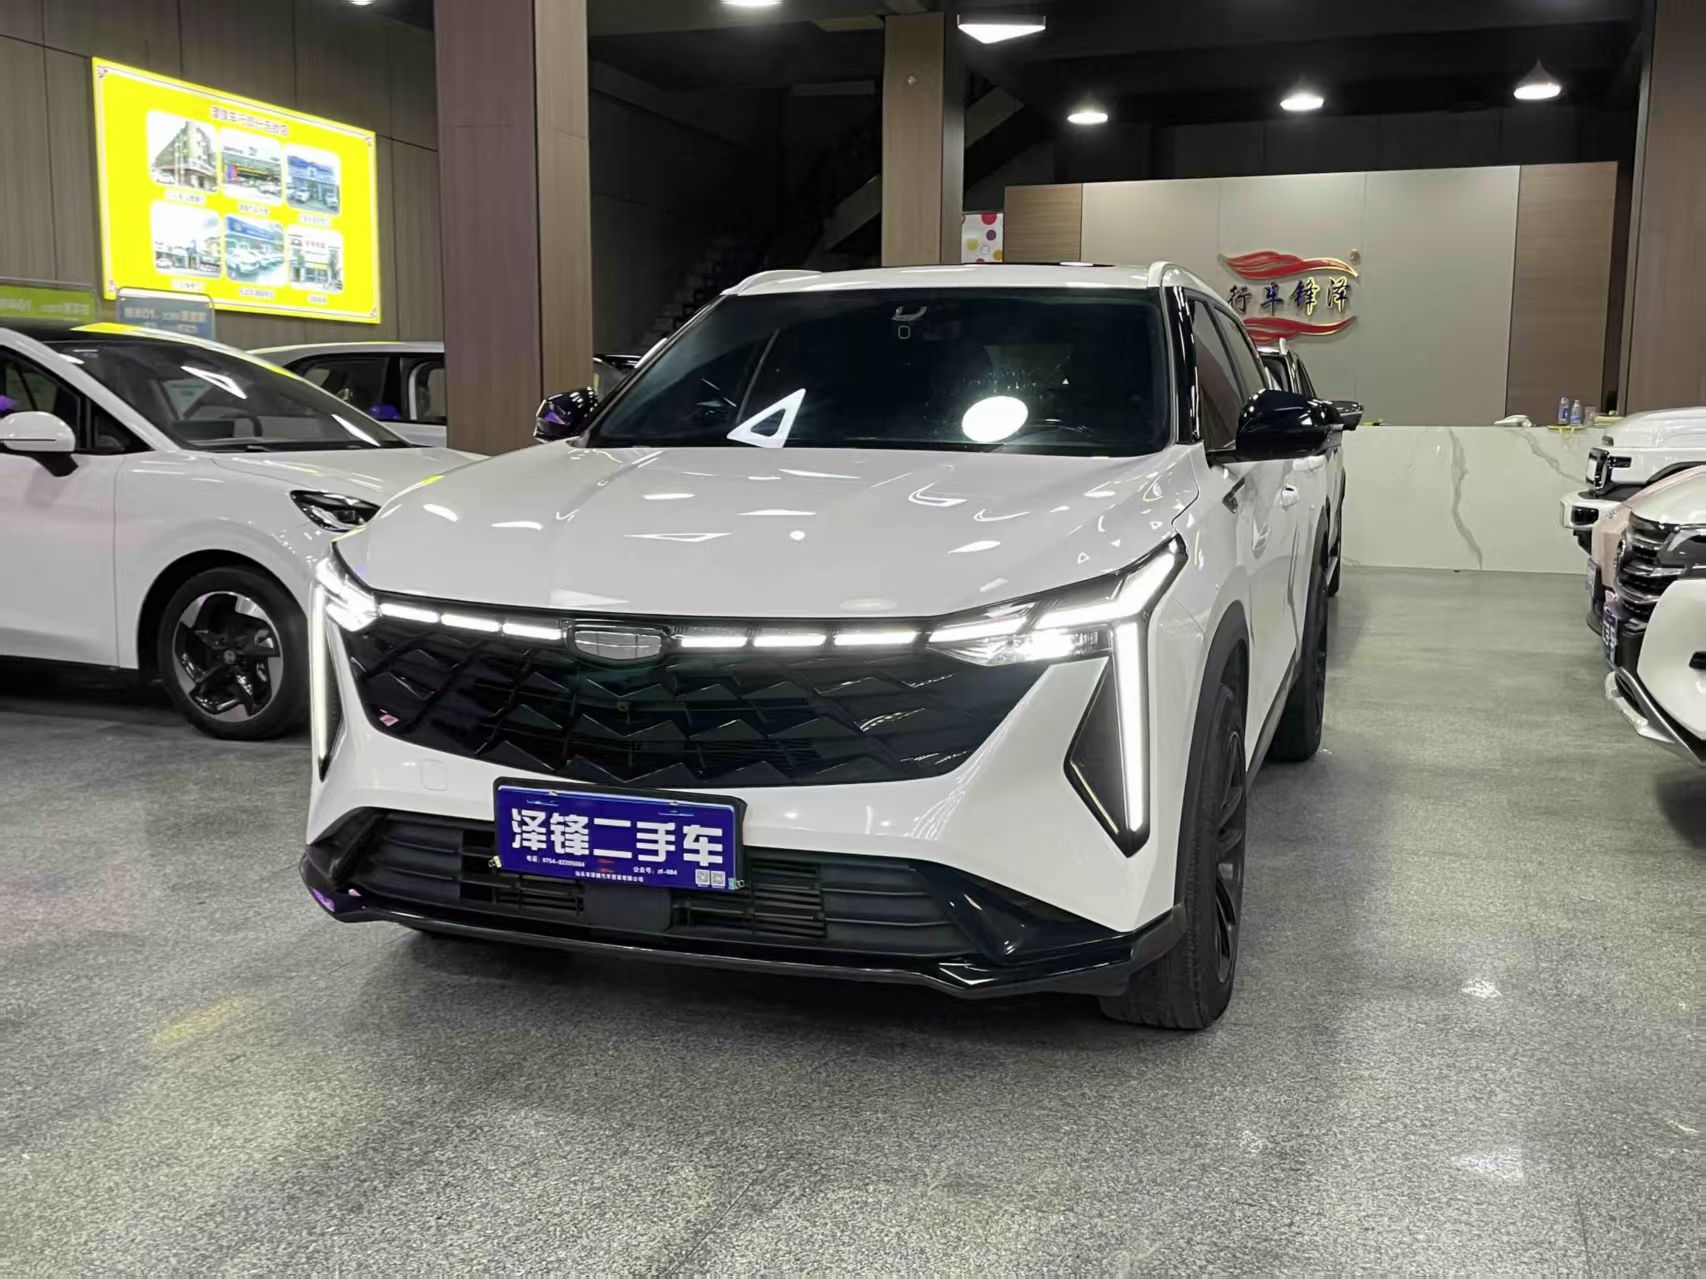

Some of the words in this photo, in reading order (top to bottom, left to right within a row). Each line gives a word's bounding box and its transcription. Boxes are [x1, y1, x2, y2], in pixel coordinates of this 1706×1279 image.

[511, 808, 724, 867] 泽锋二手车
